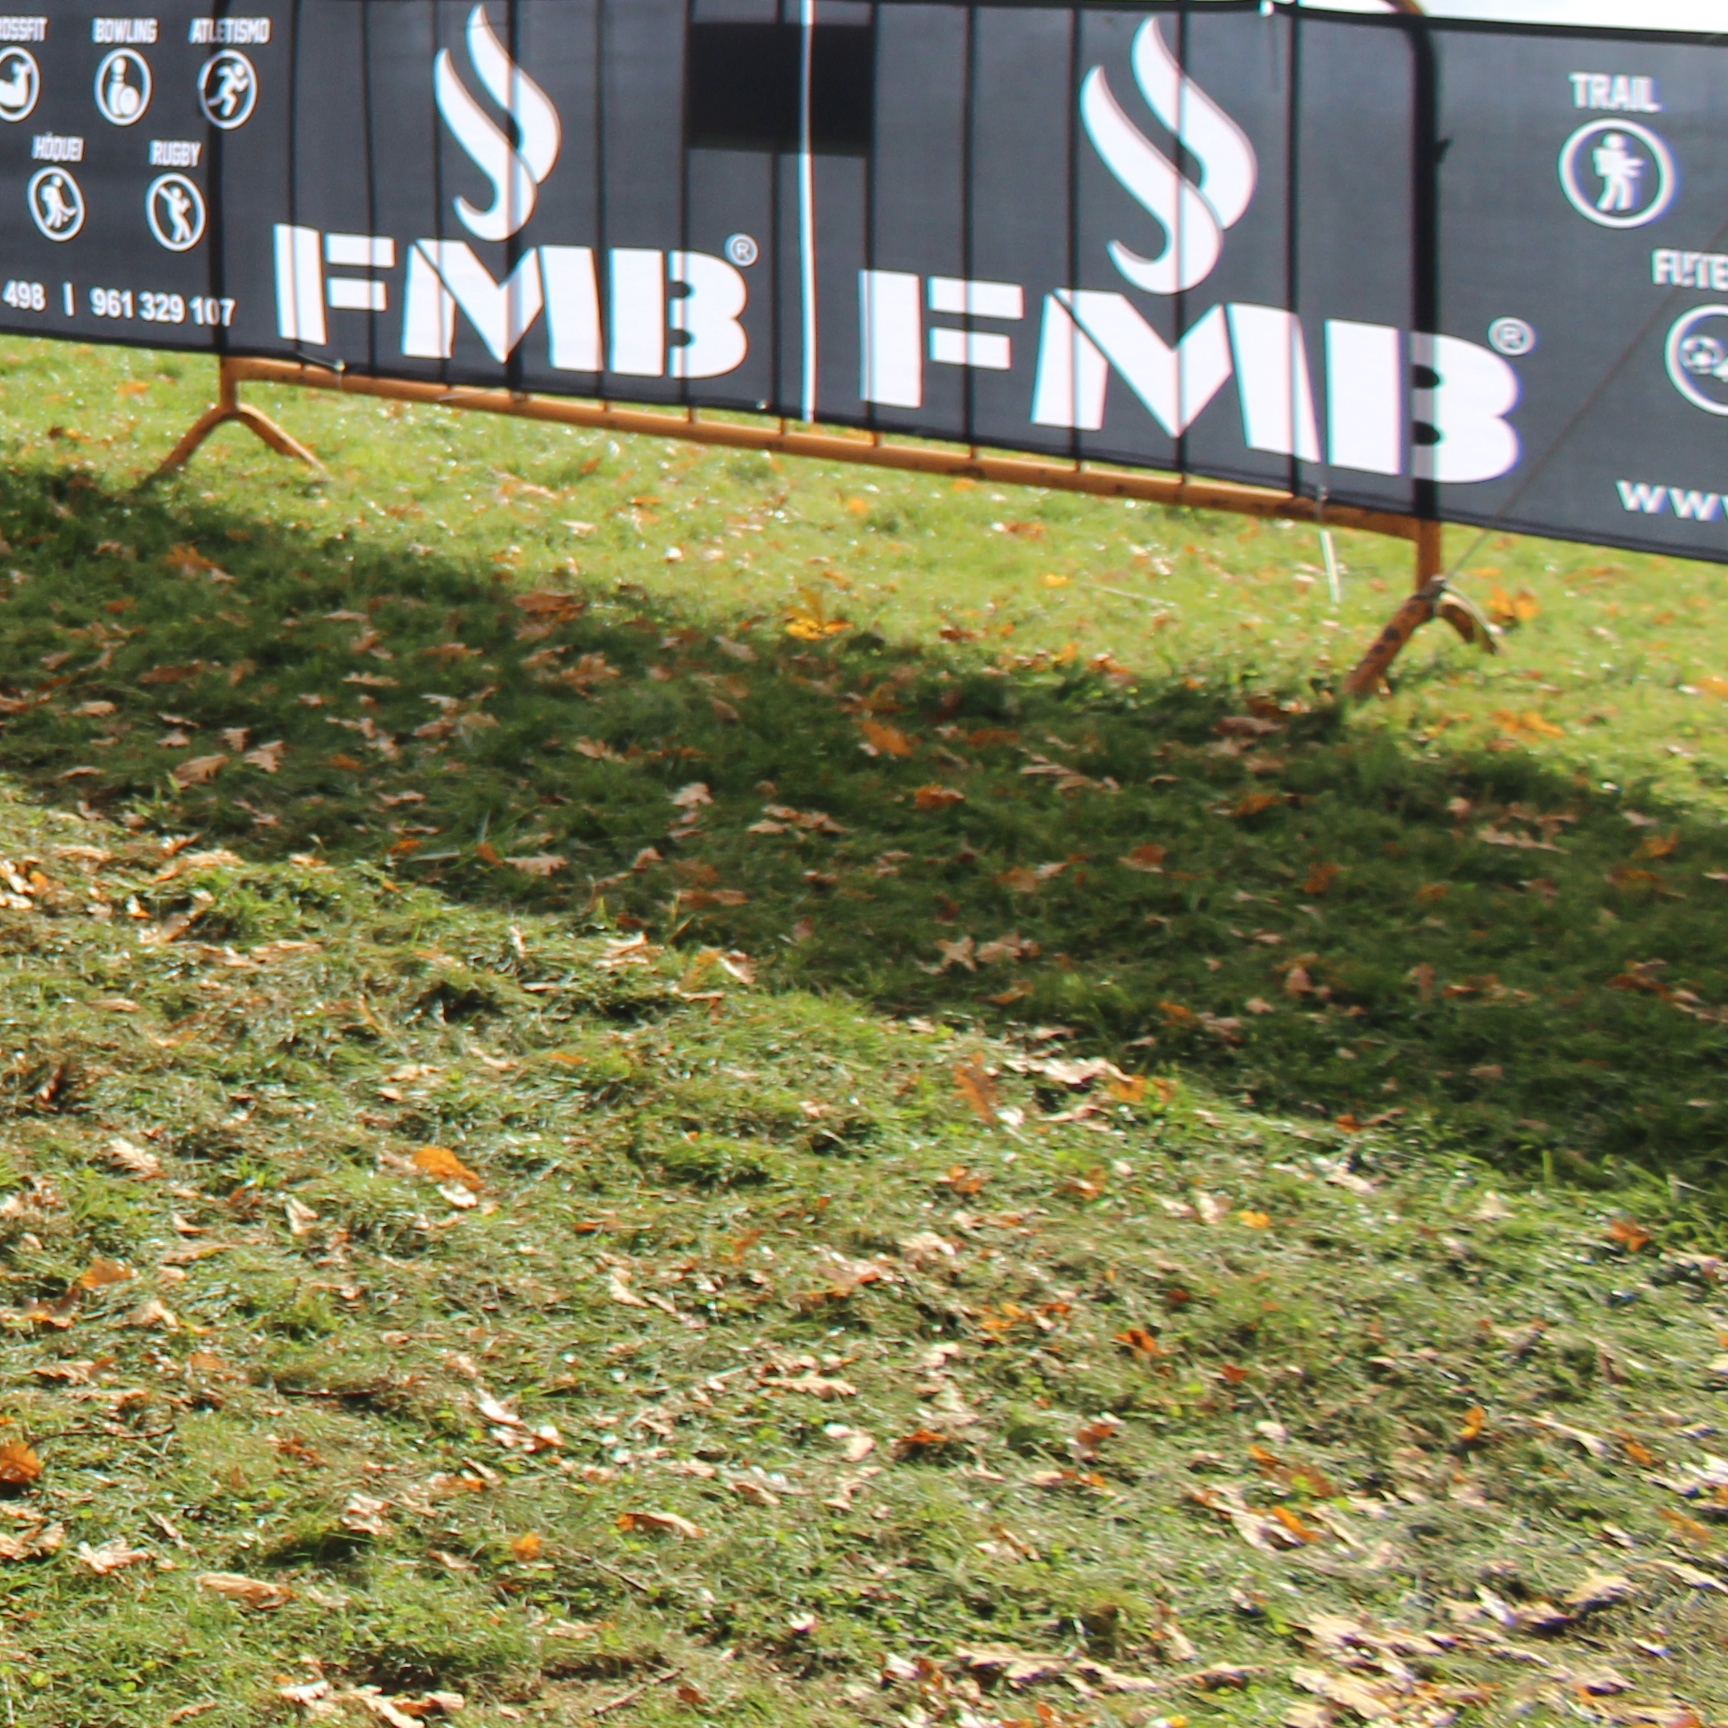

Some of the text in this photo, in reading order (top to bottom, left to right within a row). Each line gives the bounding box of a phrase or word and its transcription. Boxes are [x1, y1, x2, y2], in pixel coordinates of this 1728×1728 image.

[91, 16, 158, 45] BOWLING
[188, 16, 271, 45] ATLETISMO
[1568, 71, 1663, 113] TRAIL
[31, 131, 85, 163] HÓQUEI
[149, 139, 203, 168] RUGBY
[1, 280, 46, 312] 498
[89, 286, 135, 319] 961
[138, 290, 186, 324] 329
[188, 295, 237, 327] 107
[273, 223, 749, 379] FMB
[859, 268, 1522, 484] FMB
[1615, 478, 1728, 524] WW
